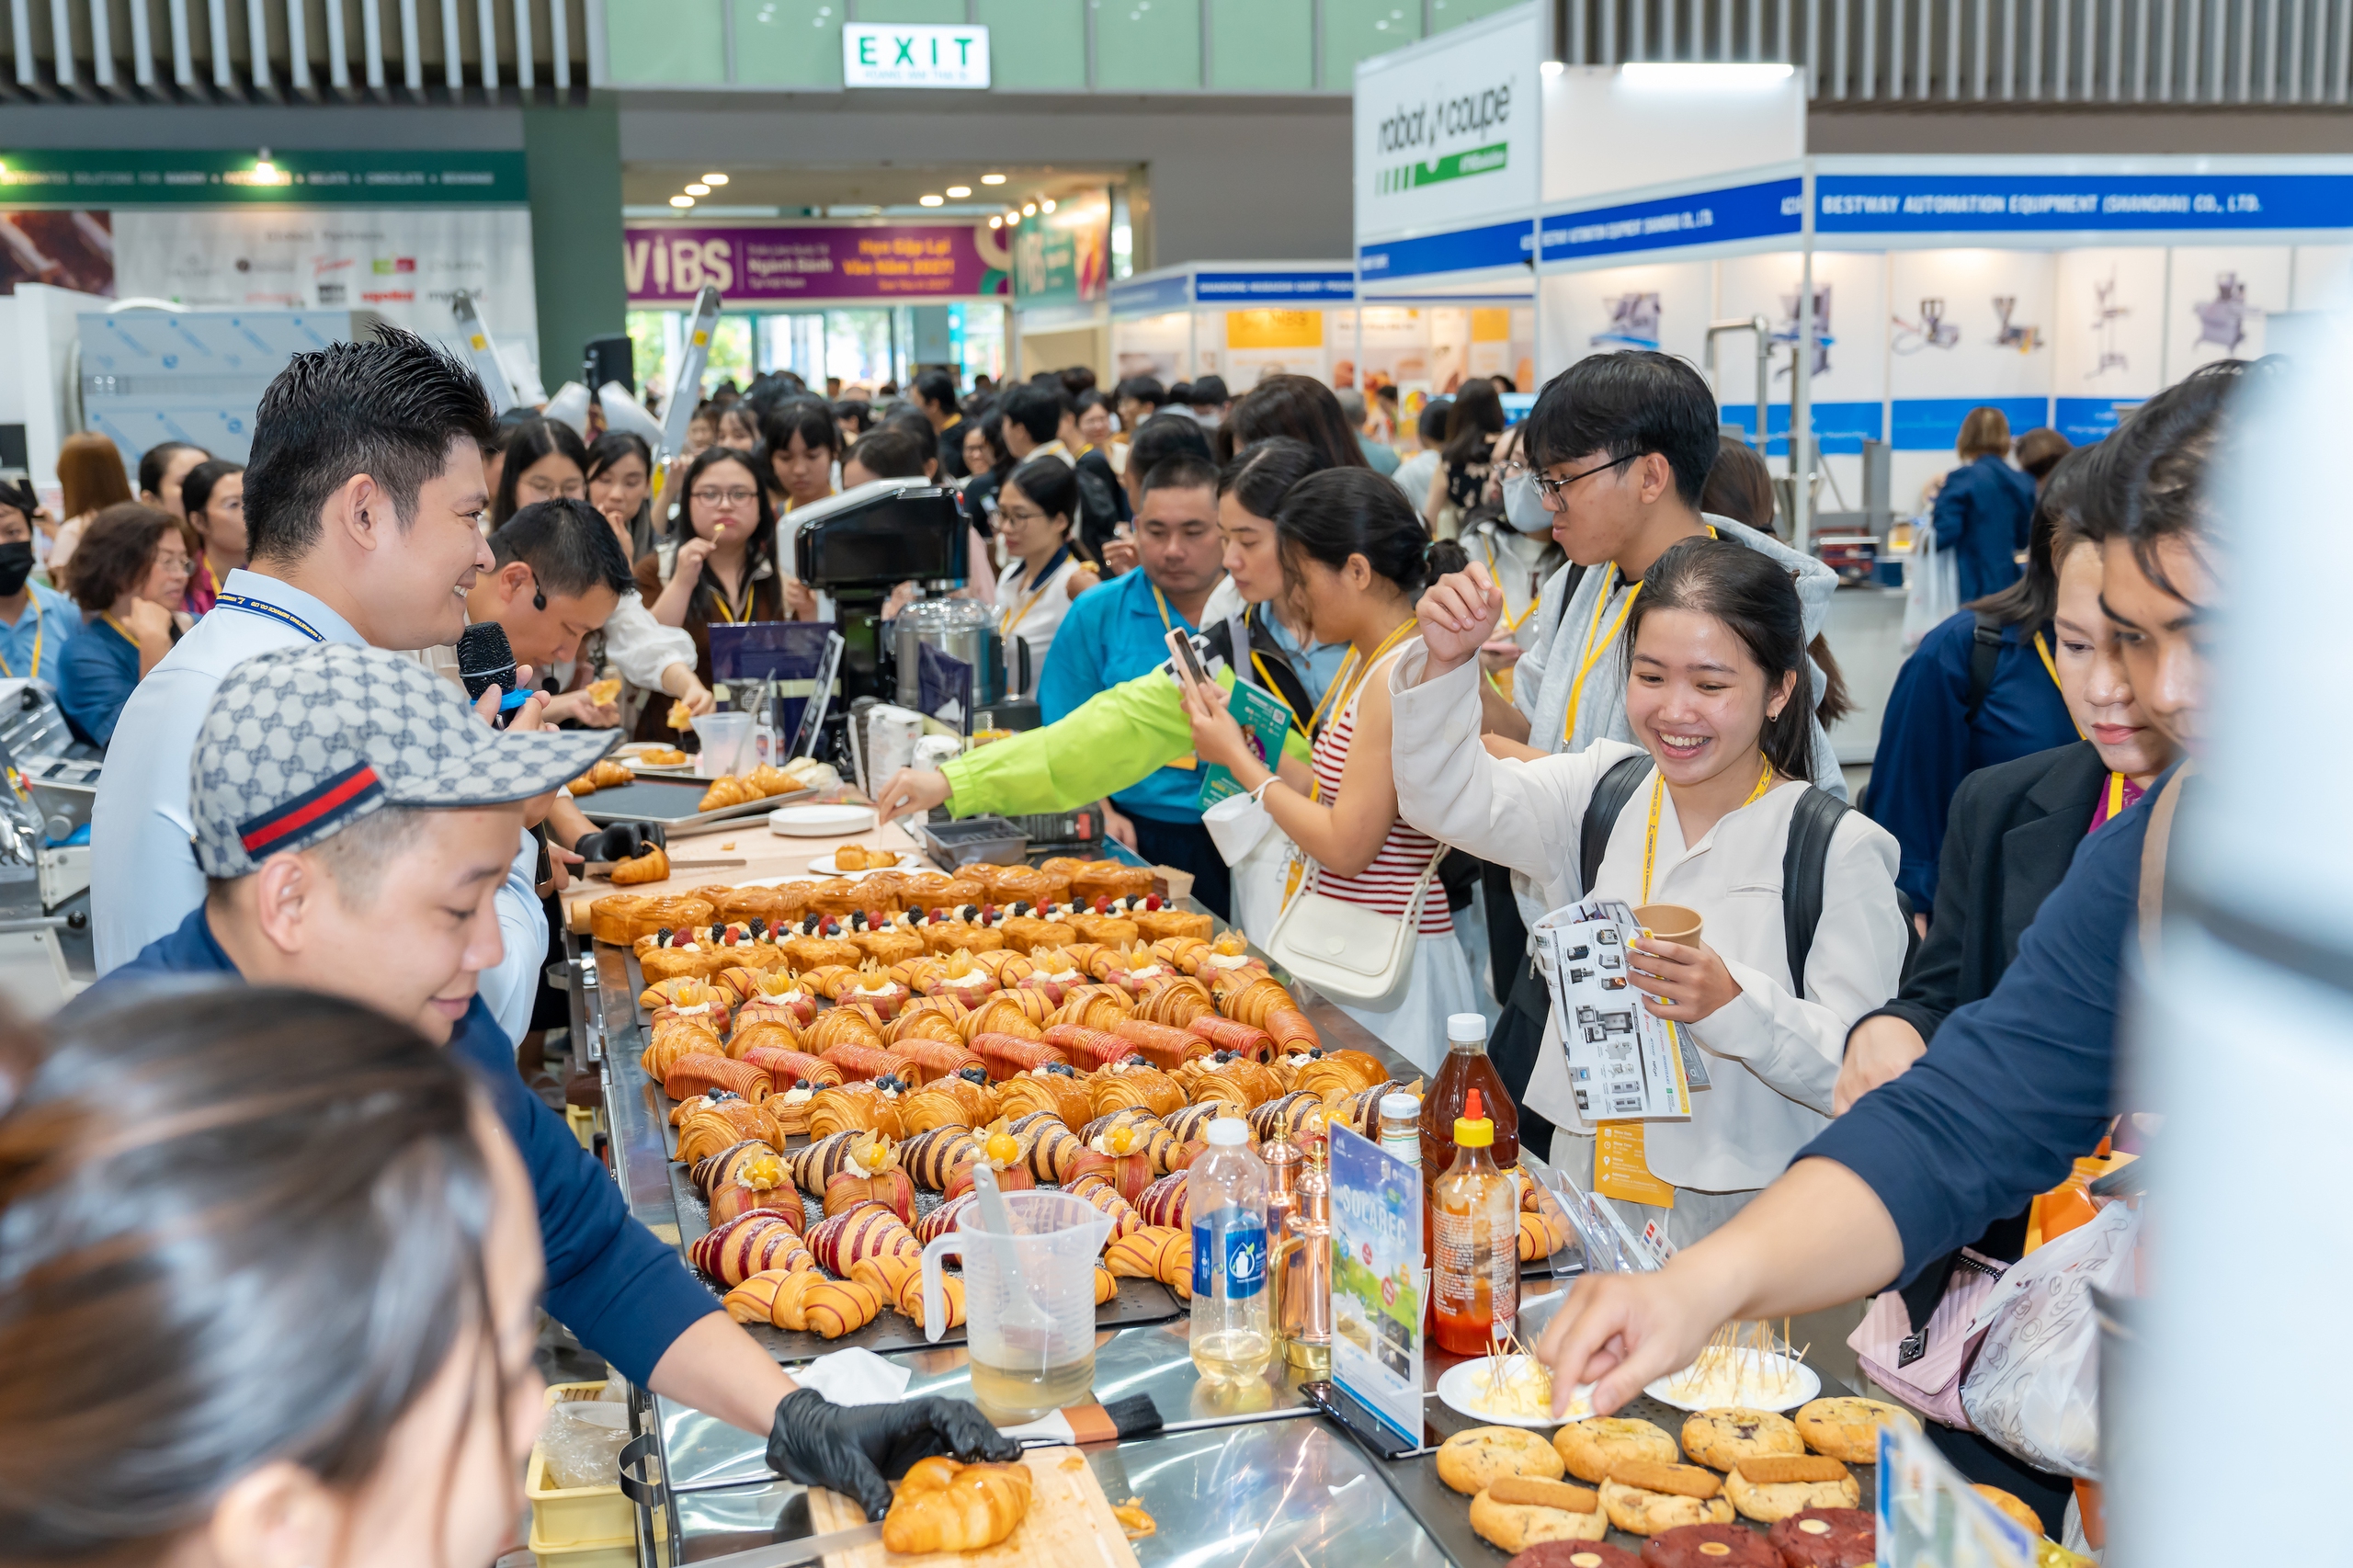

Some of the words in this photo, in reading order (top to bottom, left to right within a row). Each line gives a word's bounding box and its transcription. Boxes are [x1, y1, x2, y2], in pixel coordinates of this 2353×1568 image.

[859, 37, 972, 65] EXIT
[1379, 100, 1427, 153] robot
[1446, 84, 1511, 142] coupe
[1822, 194, 1901, 214] BESTWAY
[1903, 194, 2006, 214] AUTOMATION
[2008, 193, 2098, 215] EQUIPMENT
[2102, 193, 2191, 215] (SHANGHAI)
[267, 606, 290, 619] SERVICE
